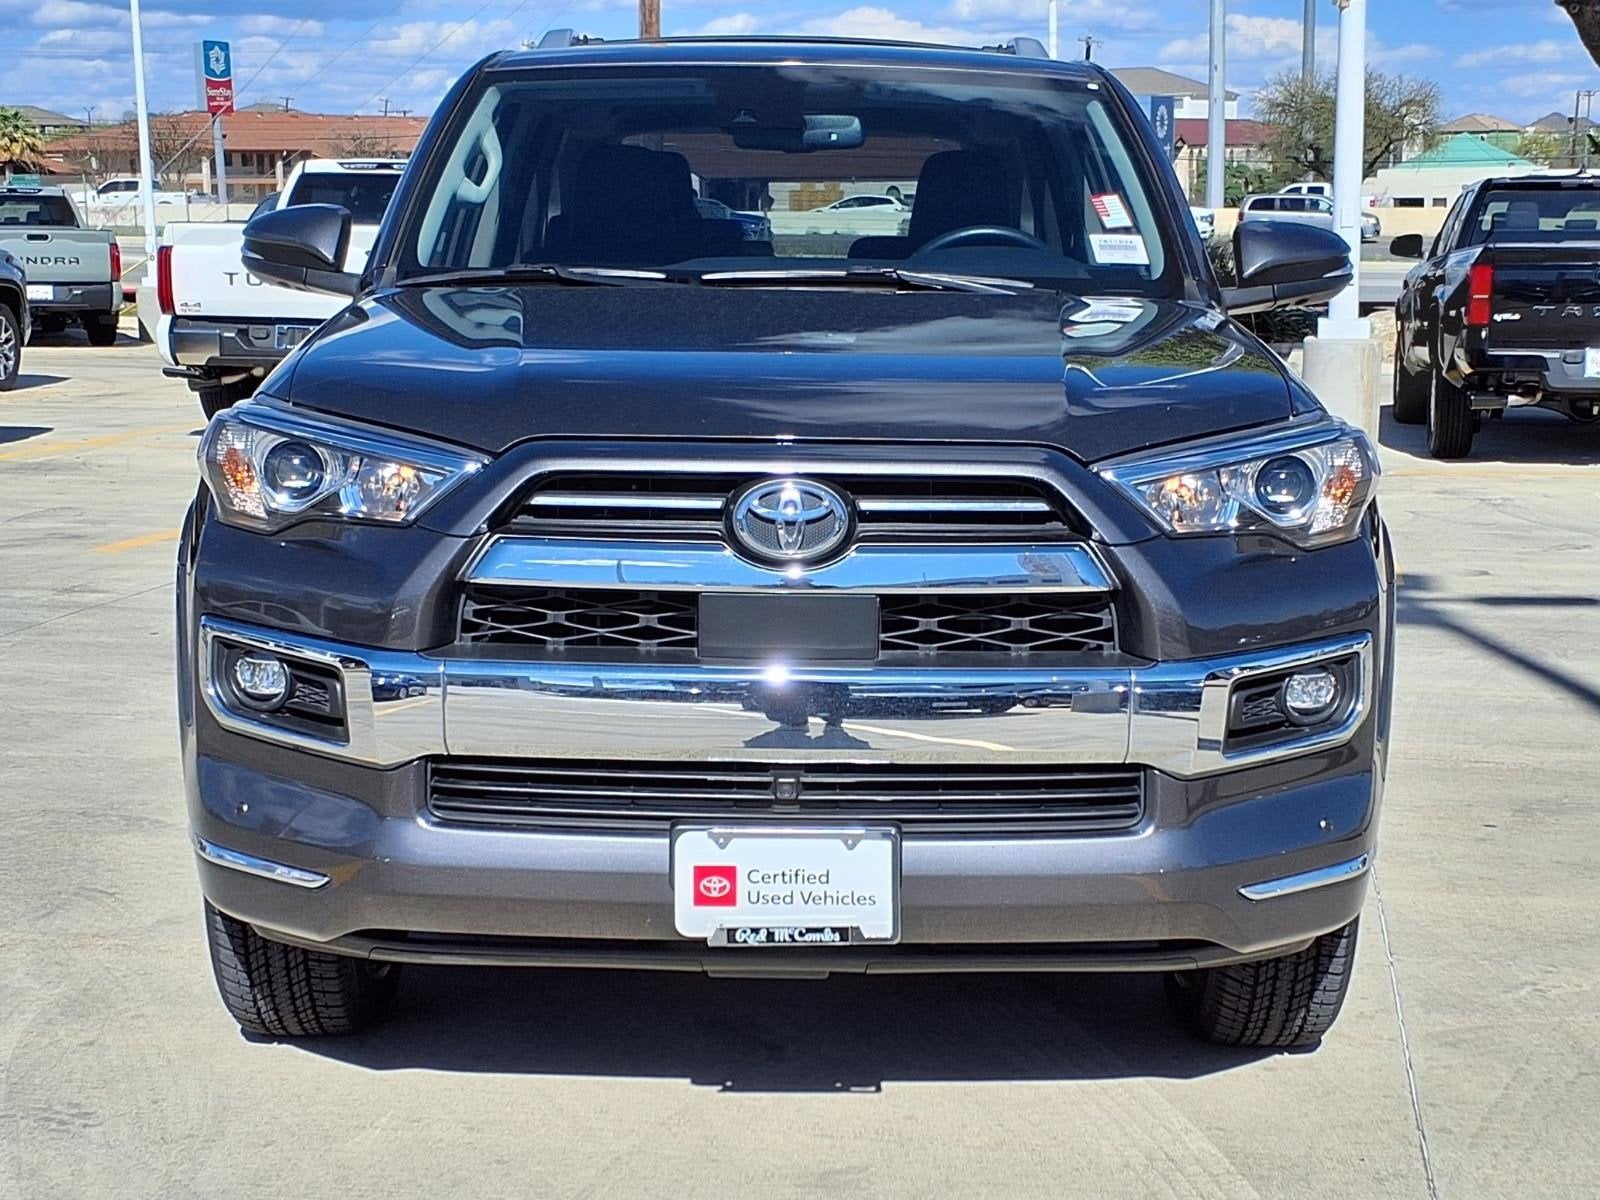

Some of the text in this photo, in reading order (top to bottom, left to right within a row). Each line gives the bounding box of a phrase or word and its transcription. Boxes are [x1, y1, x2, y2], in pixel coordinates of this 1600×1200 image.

[20, 256, 80, 265] NDRA
[747, 869, 830, 885] Certified
[747, 890, 877, 906] Used Vehicles
[735, 927, 841, 943] Red McCombs
